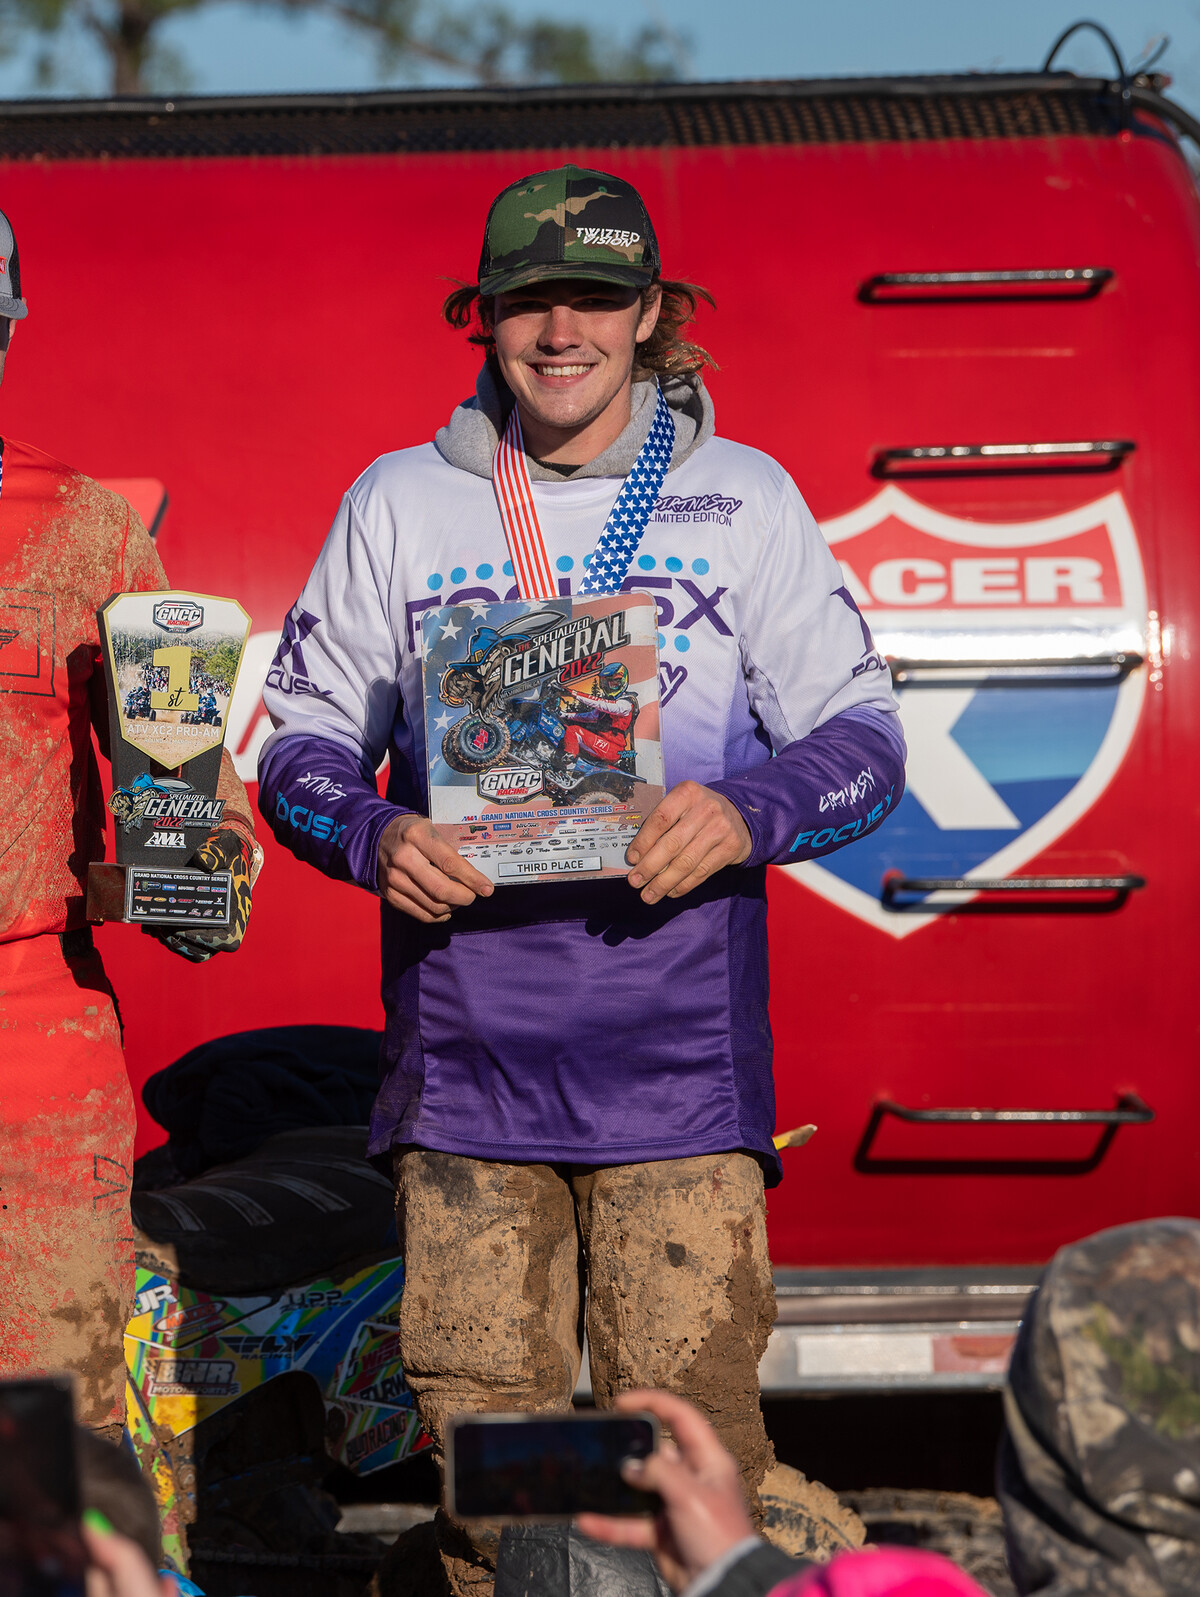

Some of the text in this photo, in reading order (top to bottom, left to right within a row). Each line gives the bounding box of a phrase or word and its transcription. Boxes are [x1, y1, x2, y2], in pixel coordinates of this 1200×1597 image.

[576, 227, 640, 243] TWIZTED
[583, 235, 632, 247] VISION
[693, 512, 731, 527] EDITION
[157, 607, 201, 620] GNCC
[518, 617, 589, 652] THE SPECIALIZED
[504, 616, 625, 687] GENERAL
[560, 652, 602, 682] 2022
[151, 647, 199, 711] 1
[168, 688, 186, 707] st
[127, 724, 219, 738] ATV XC2 PRO-AM
[482, 771, 540, 790] GNCC
[496, 788, 528, 796] RACING
[144, 799, 222, 819] GENERAL
[505, 811, 535, 820] NATIONAL
[537, 809, 558, 818] CROSS
[560, 807, 588, 816] COUNTRY
[591, 805, 613, 814] SERIES
[154, 816, 183, 828] 2022
[144, 832, 186, 848] AMA
[517, 859, 584, 872] THIRD PLACE
[155, 1360, 233, 1383] BNR
